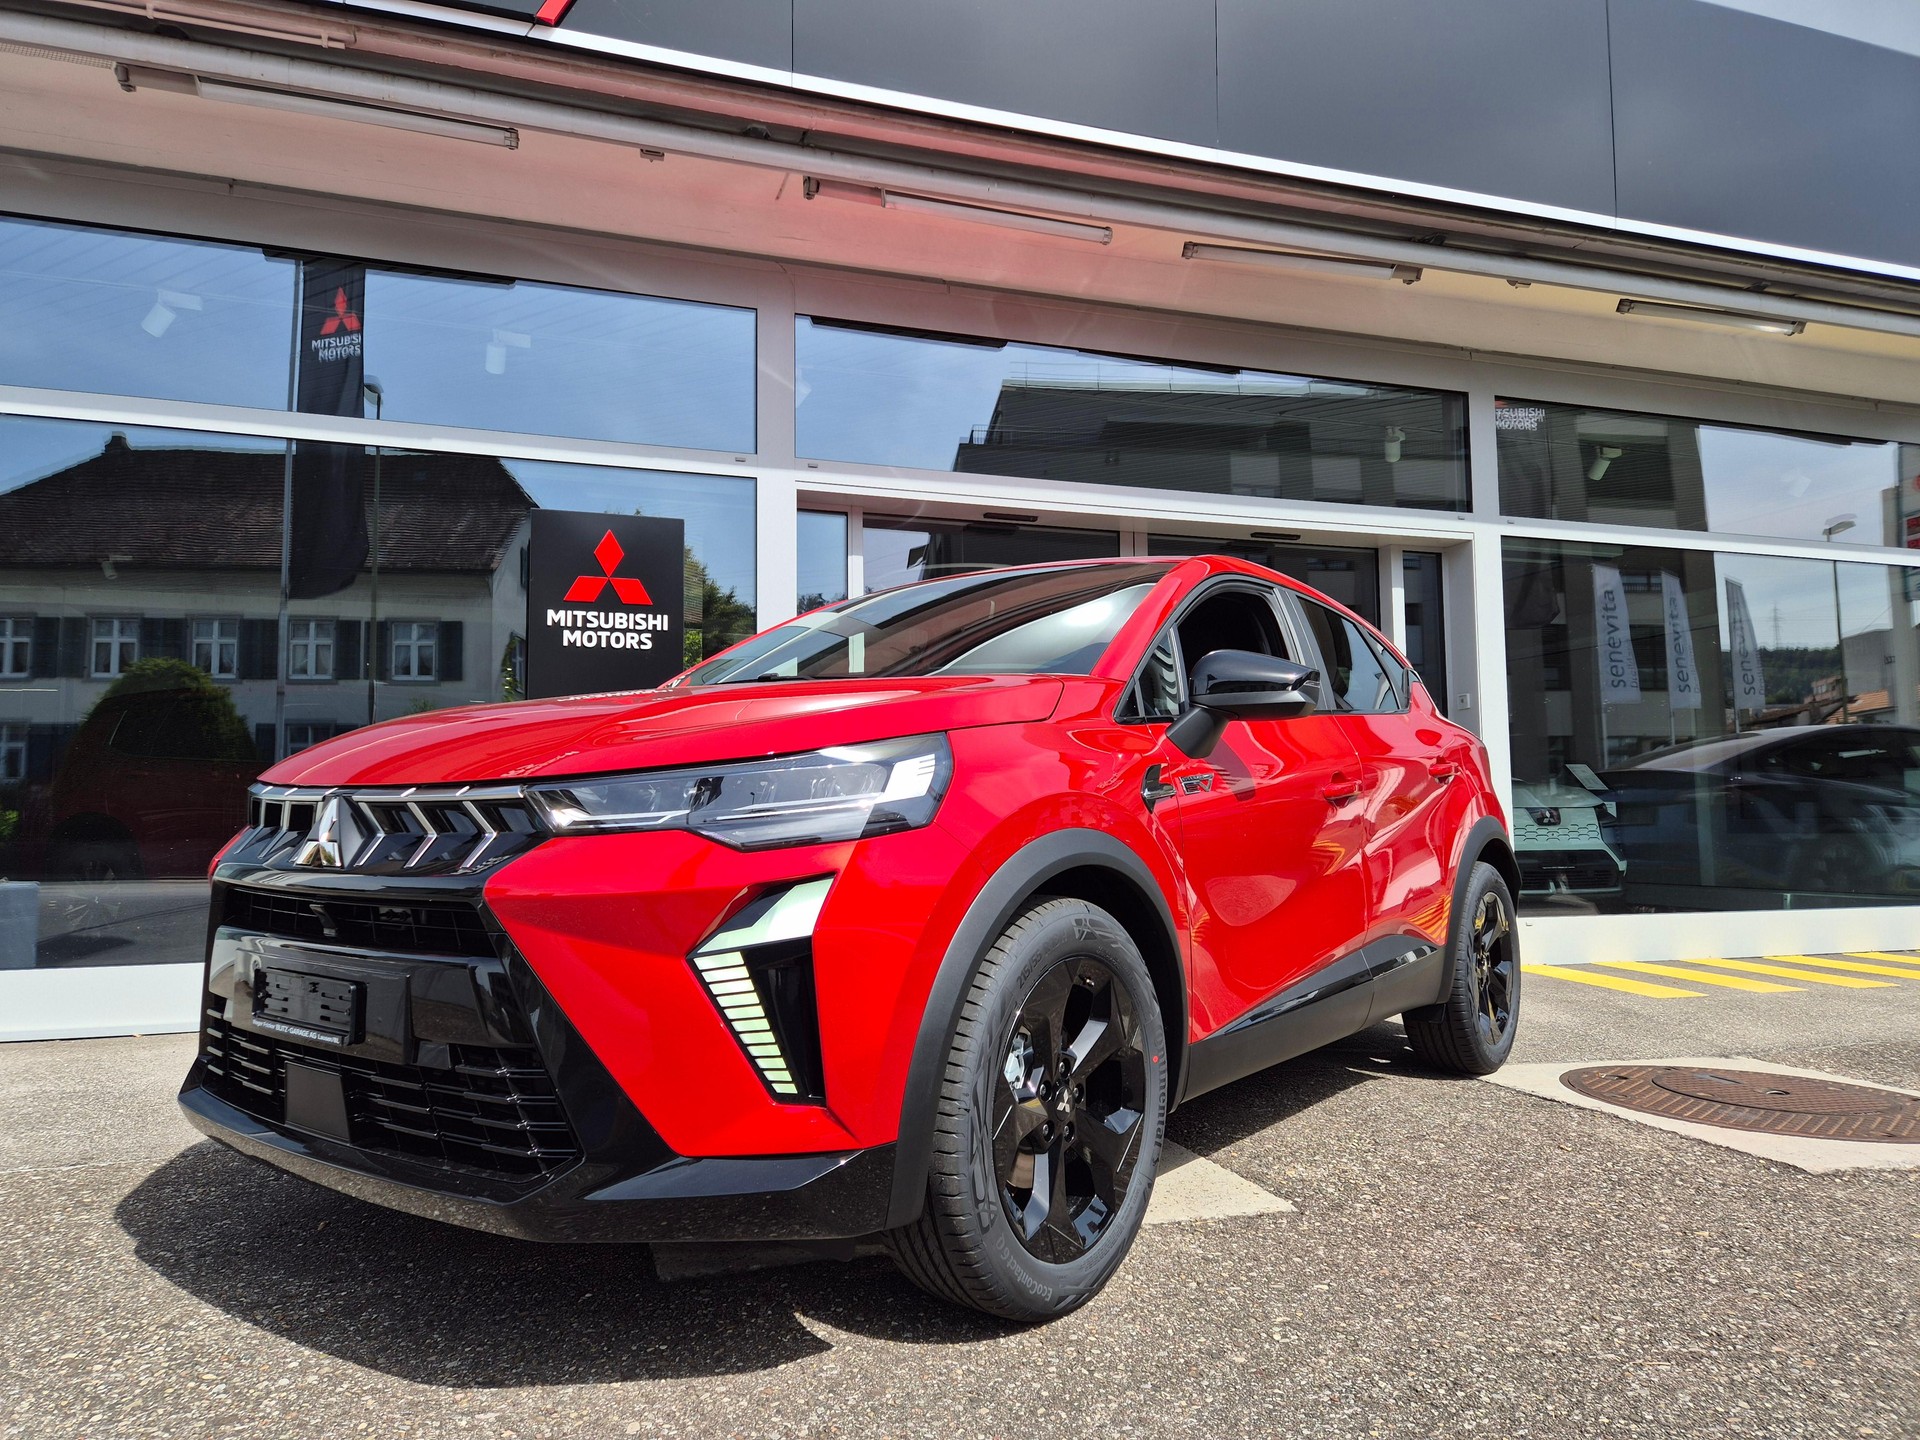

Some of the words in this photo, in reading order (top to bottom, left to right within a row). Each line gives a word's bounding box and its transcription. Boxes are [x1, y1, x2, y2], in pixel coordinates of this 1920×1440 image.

[1495, 407, 1546, 421] TSUBISHI
[546, 609, 669, 631] MITSUBISHI
[562, 629, 653, 650] MOTORS
[1601, 589, 1627, 689] senevita
[1669, 597, 1692, 694] senevita
[1007, 1255, 1053, 1302] EcoContact
